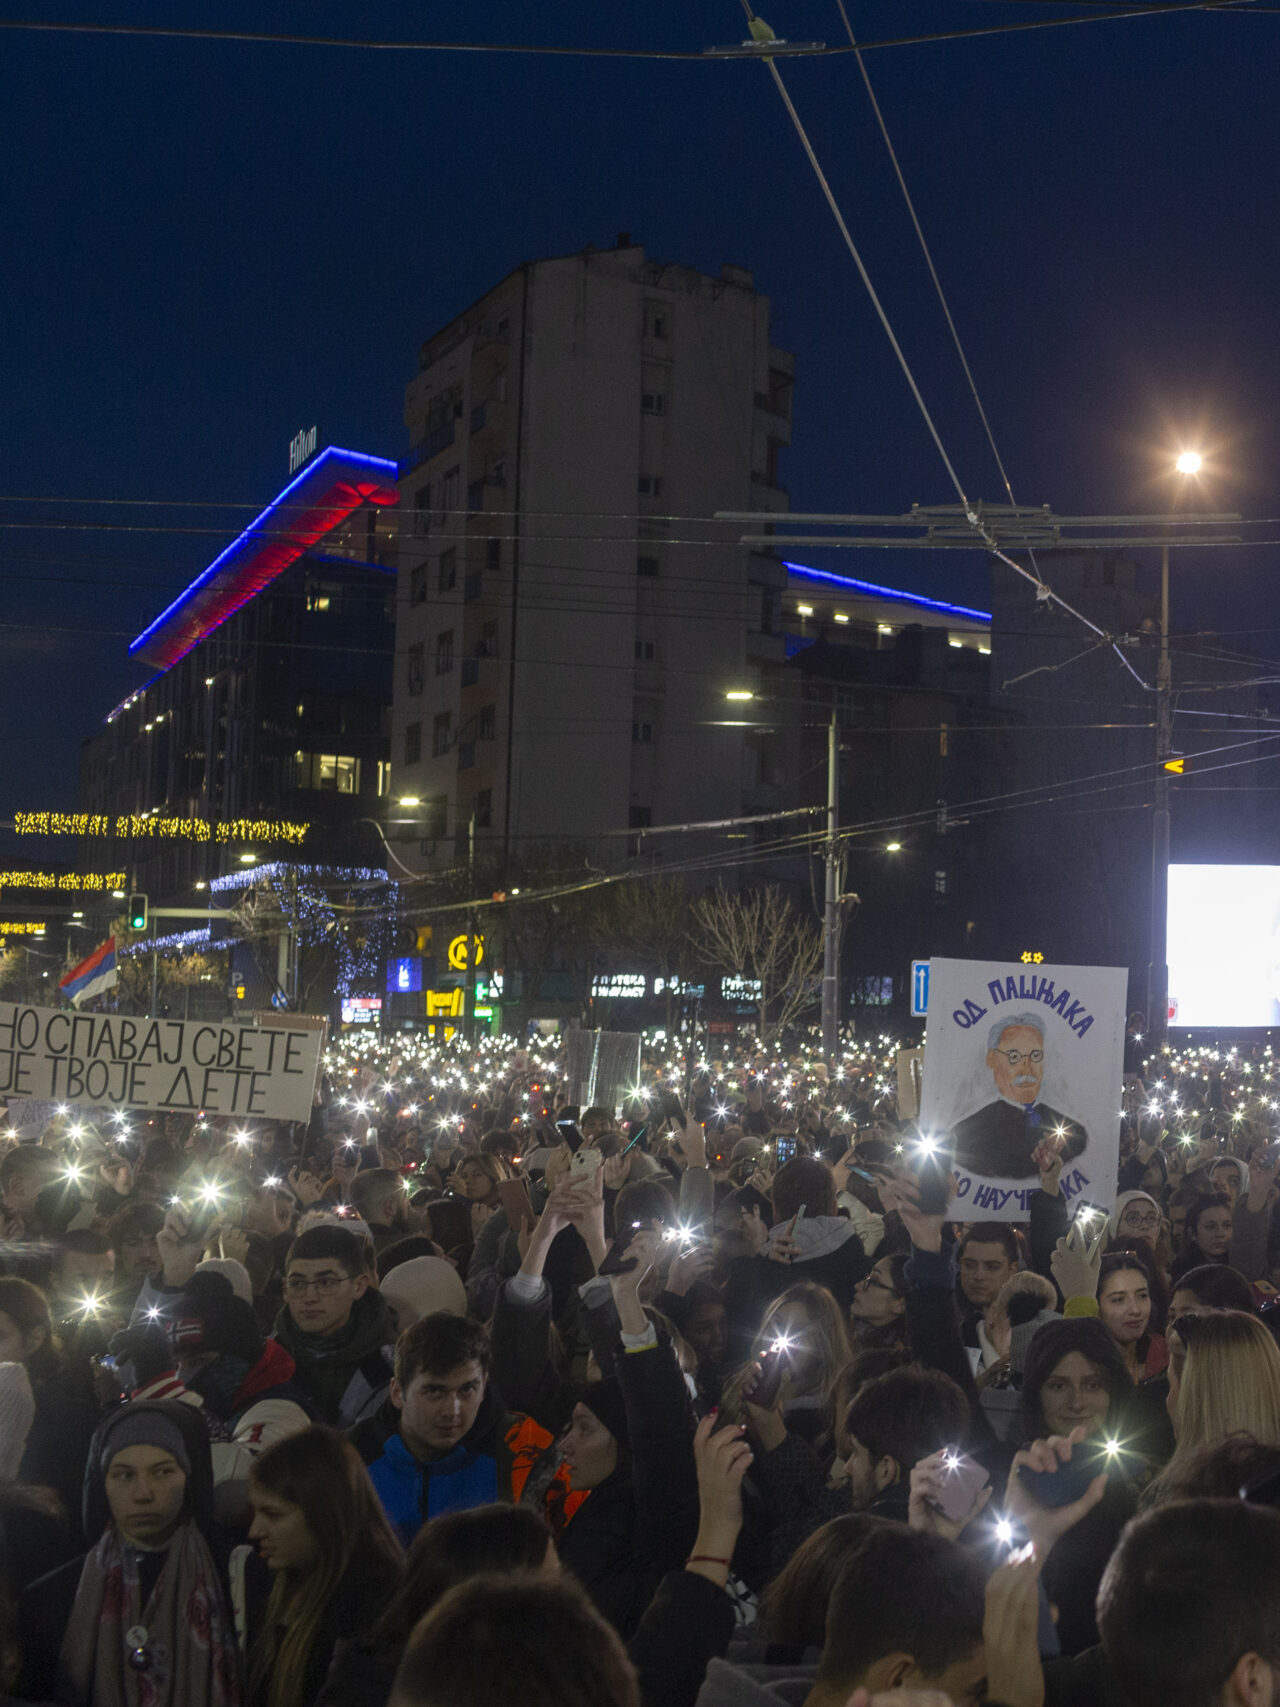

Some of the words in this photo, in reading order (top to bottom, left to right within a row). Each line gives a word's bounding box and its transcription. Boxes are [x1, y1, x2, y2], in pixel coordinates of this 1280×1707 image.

[289, 424, 317, 474] Hilton
[952, 998, 988, 1029] ОД
[987, 974, 1095, 1039] ПАШЊАКА
[45, 1014, 185, 1065] СПАВАЈ
[193, 1026, 309, 1074] СВЕТЕ
[44, 1054, 152, 1105] ТВОЈЕ
[157, 1066, 272, 1114] ДЕТЕ
[954, 1171, 971, 1198] О
